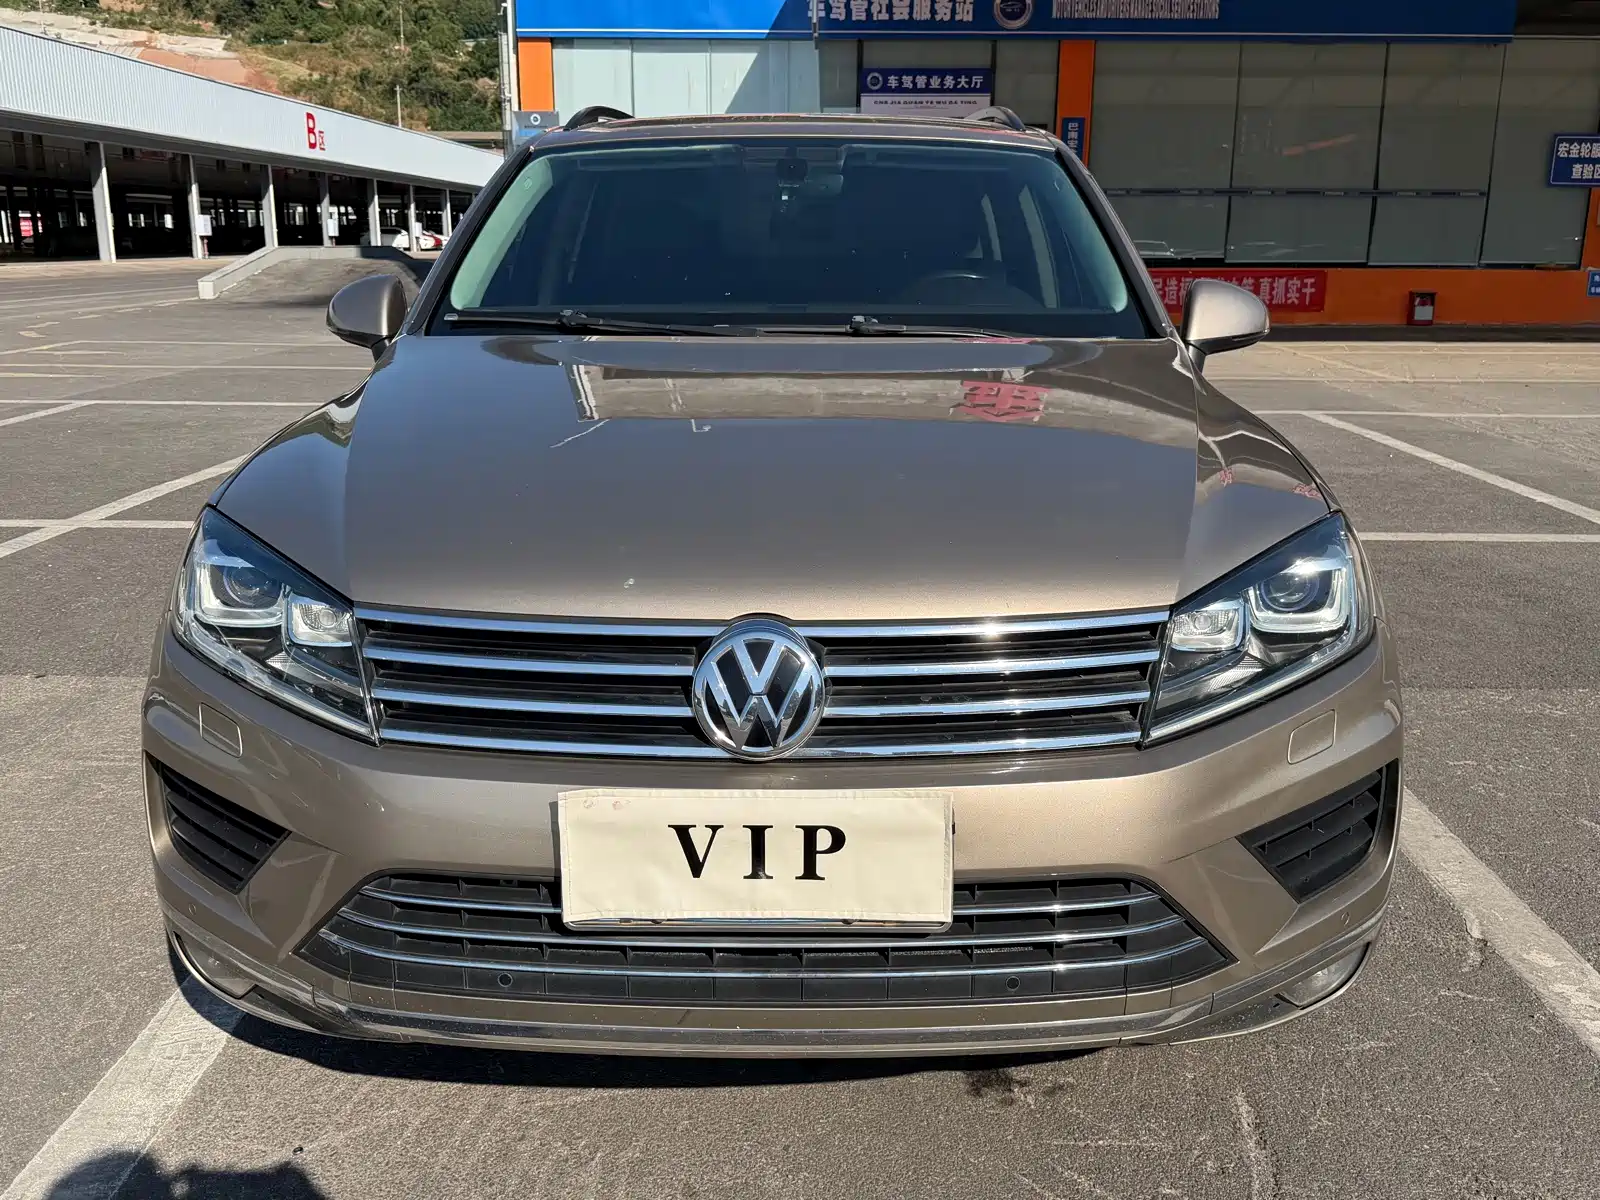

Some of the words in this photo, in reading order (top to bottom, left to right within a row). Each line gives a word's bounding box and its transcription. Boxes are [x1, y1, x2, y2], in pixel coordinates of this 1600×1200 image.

[887, 75, 984, 89] 车驾管业务大厅
[668, 824, 847, 881] VIP
